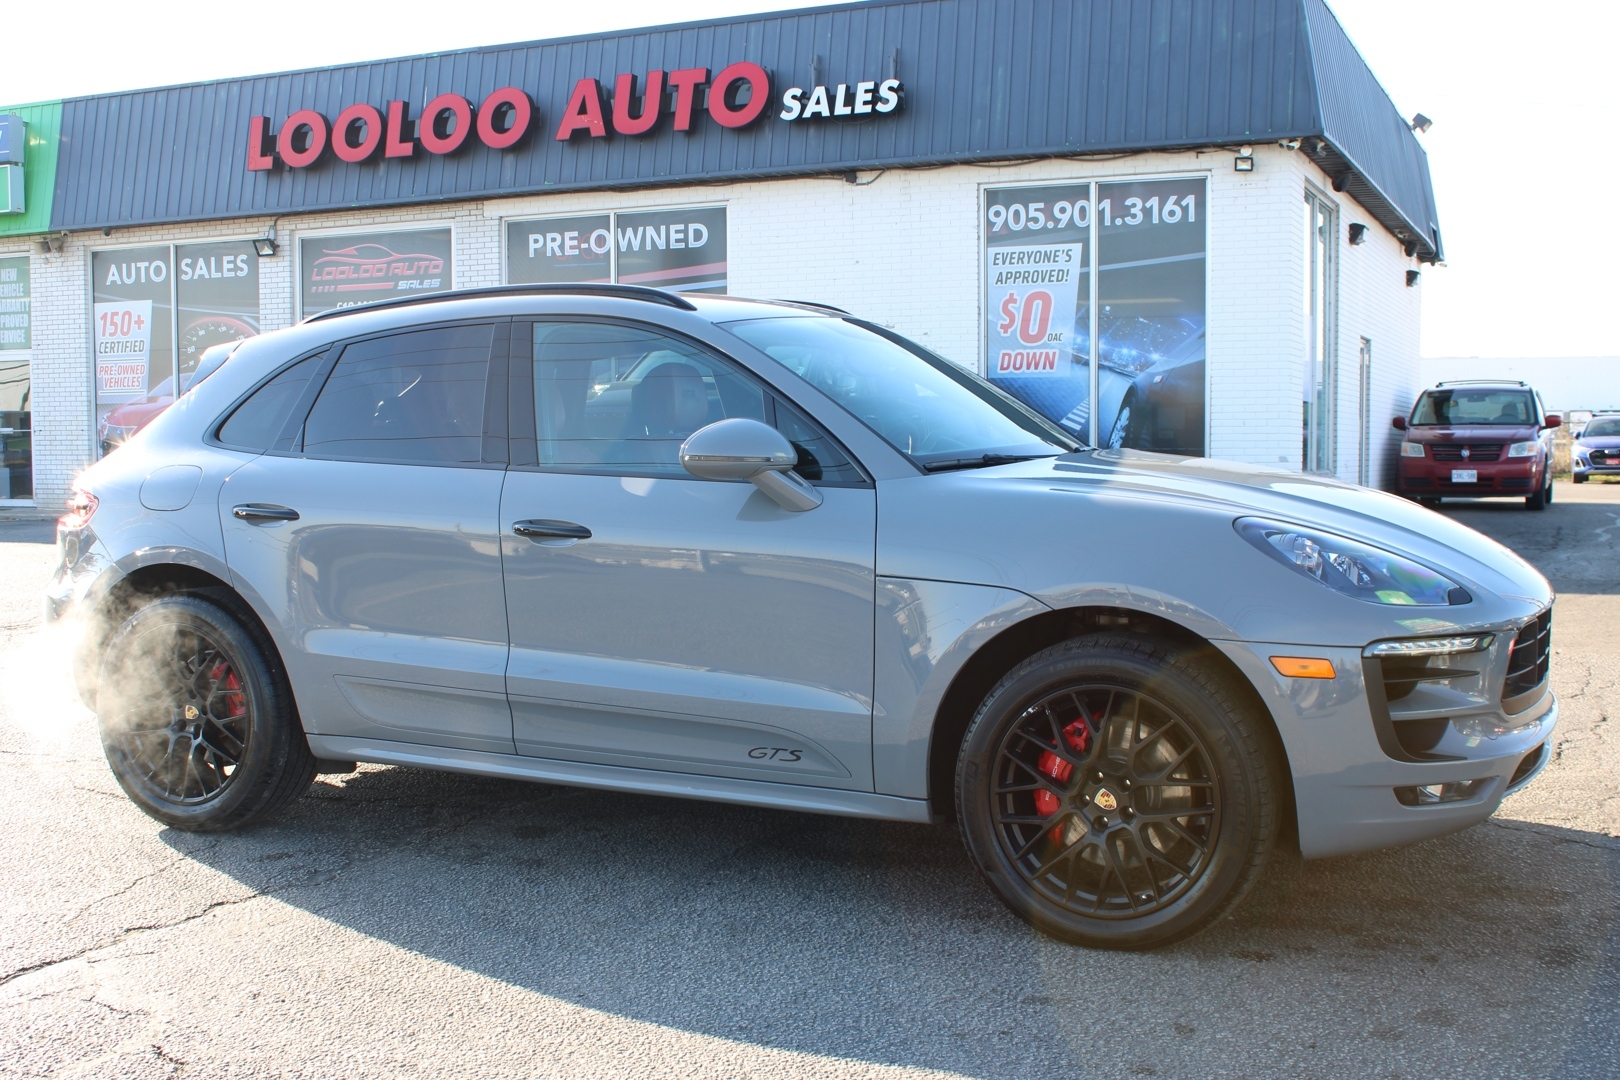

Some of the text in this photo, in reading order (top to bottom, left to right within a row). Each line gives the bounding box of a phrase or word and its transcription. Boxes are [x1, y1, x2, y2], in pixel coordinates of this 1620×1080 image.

[247, 61, 902, 171] LOOLOO AUTO SALES
[988, 194, 1196, 232] 905.901.3161
[528, 222, 709, 259] PRE-OWNED
[993, 248, 1073, 267] EVERYONE'S
[105, 253, 249, 286] AUTO SALES
[311, 260, 444, 281] LOOLOO AUTO
[995, 268, 1070, 286] APPROVED!
[0, 282, 24, 297] EHICLE
[397, 278, 442, 290] SALES
[0, 313, 29, 328] PROVED
[100, 310, 145, 338] 150+
[999, 290, 1063, 345] $0 OAC
[0, 329, 26, 344] ERVICE
[98, 339, 145, 354] CERTIFIED
[98, 364, 146, 376] PRE-OWNED
[999, 351, 1057, 372] DOWN
[104, 376, 141, 388] VEHICLES
[747, 746, 803, 762] GTS
